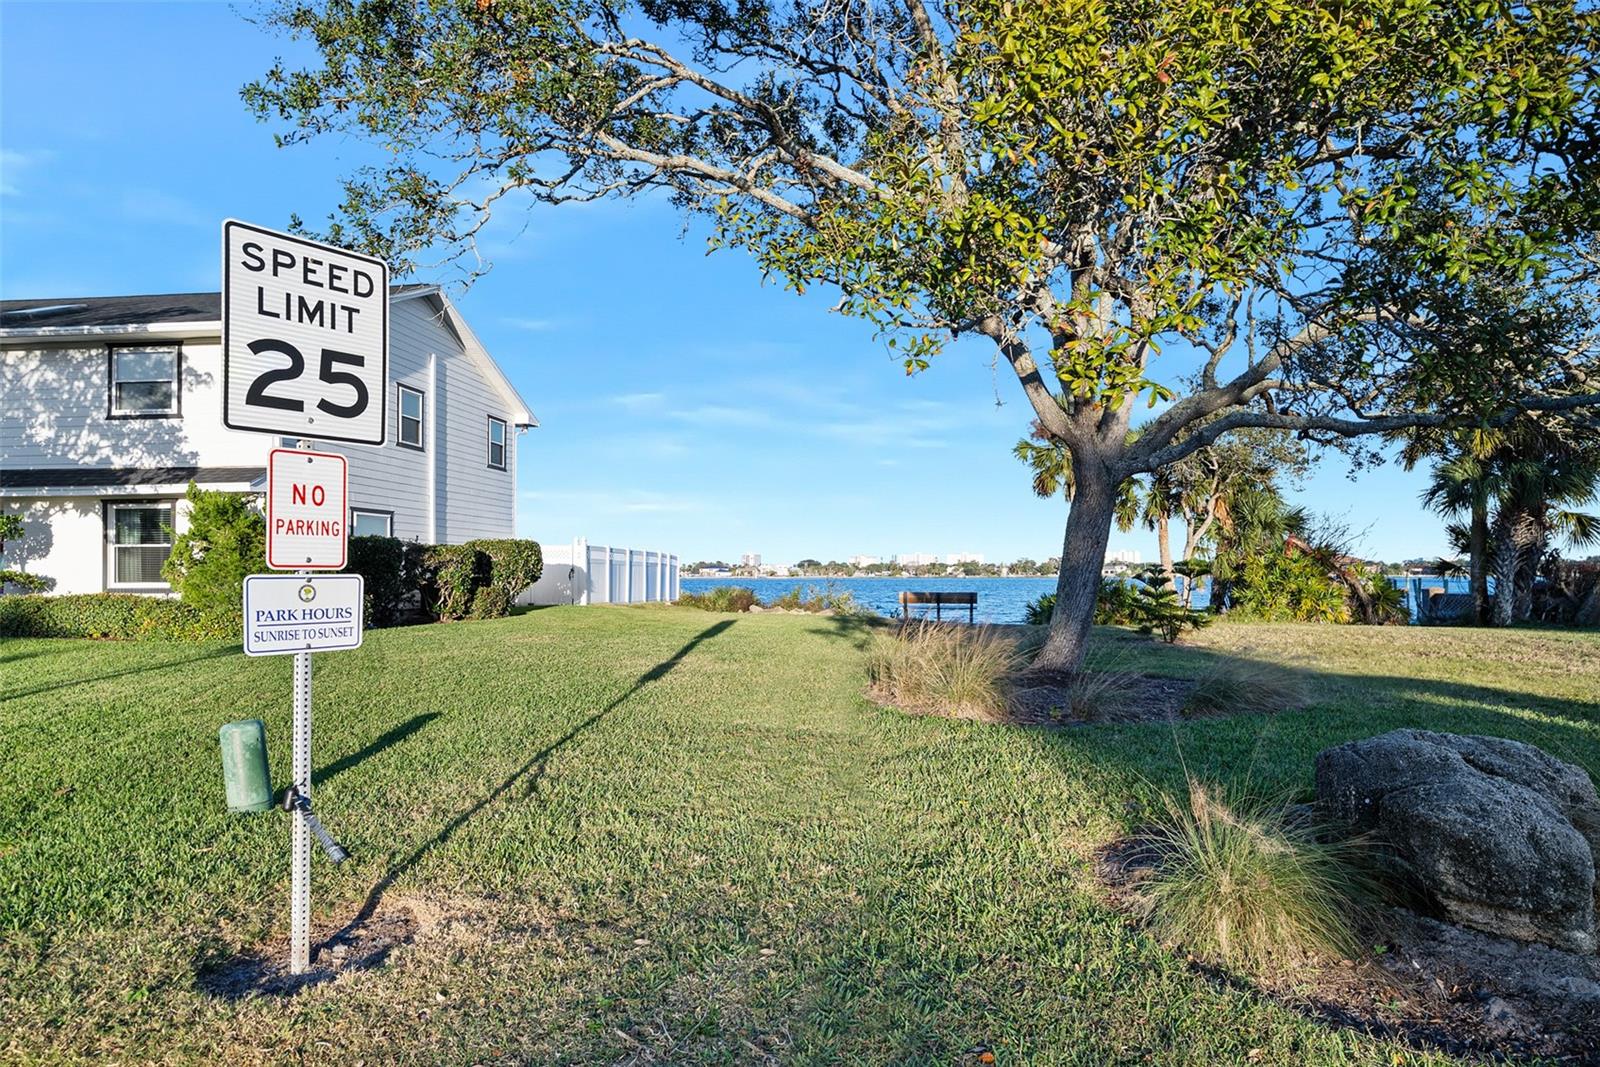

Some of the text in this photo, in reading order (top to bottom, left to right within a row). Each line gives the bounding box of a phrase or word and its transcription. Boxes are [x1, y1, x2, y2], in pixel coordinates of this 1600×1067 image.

[241, 242, 374, 298] SPEED
[258, 286, 360, 333] LIMIT
[245, 338, 369, 419] 25
[292, 483, 325, 507] NO
[276, 518, 340, 537] PARKING
[255, 607, 353, 622] PARK HOURS
[253, 626, 354, 643] SUNRISE TO SUNSET
